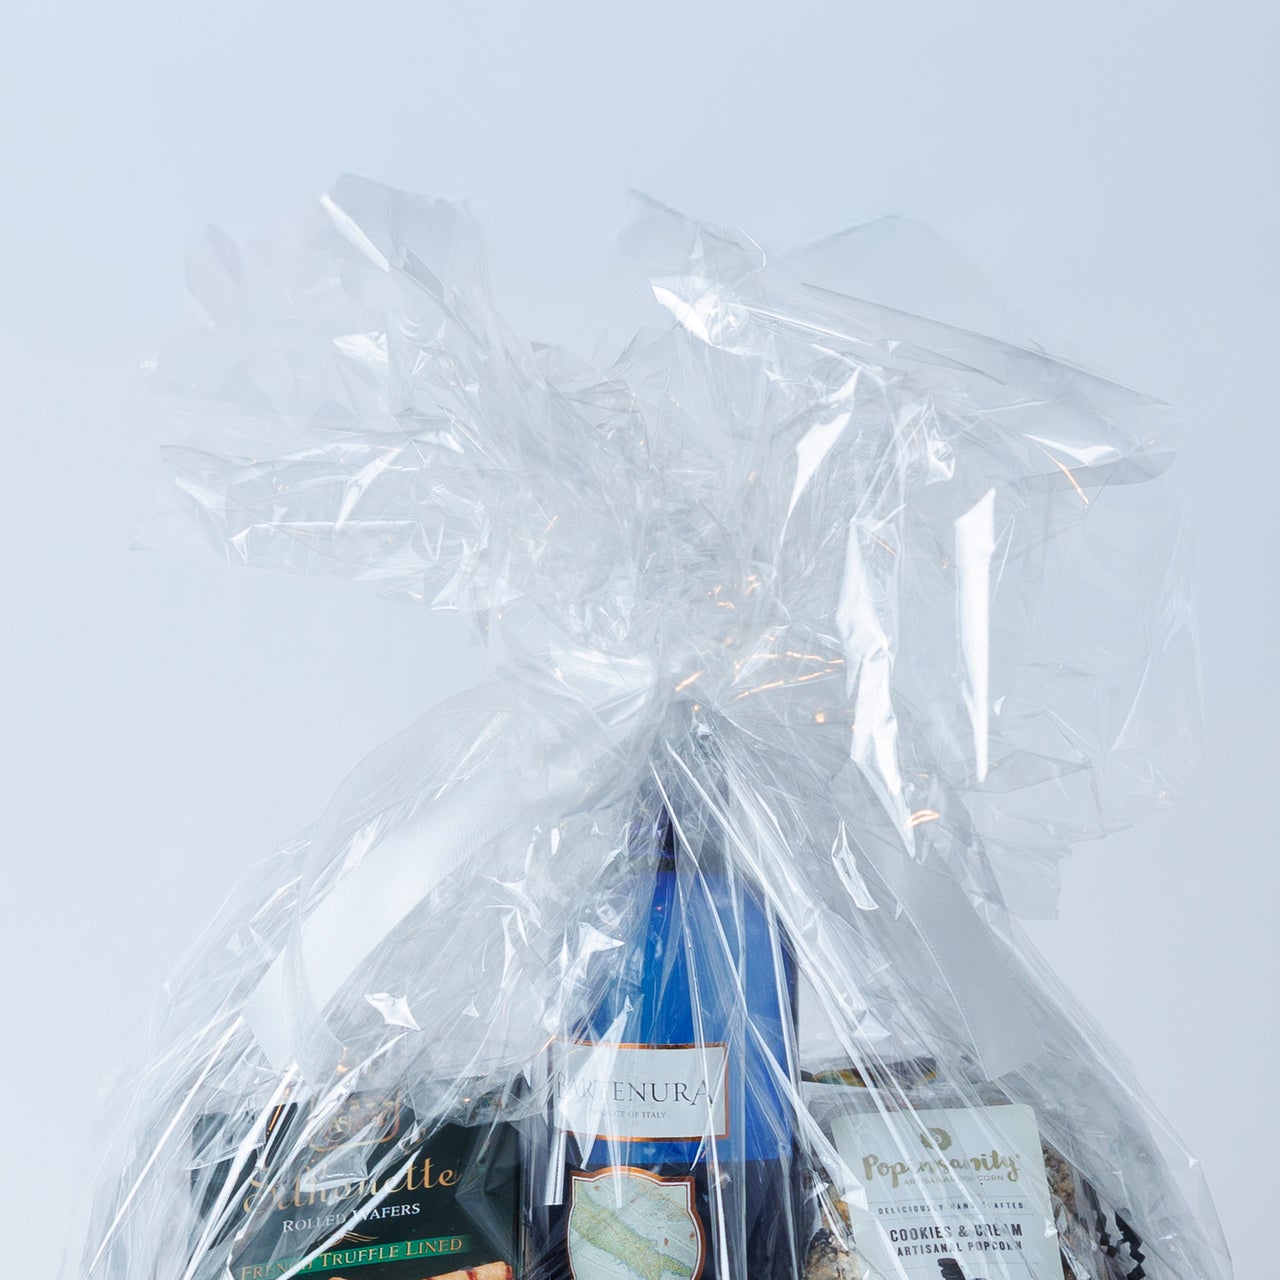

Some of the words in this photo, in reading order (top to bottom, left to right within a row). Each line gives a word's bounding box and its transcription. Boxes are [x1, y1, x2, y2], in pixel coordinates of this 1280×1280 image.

[862, 1150, 1019, 1188] Popnsanity
[283, 1214, 346, 1233] ROLLED
[890, 1225, 952, 1242] COOKIES
[959, 1225, 968, 1238] &
[240, 1259, 312, 1280] FRENH
[320, 1245, 399, 1267] TRUFFLE
[405, 1237, 462, 1257] LINED
[897, 1241, 963, 1257] ARTISANL
